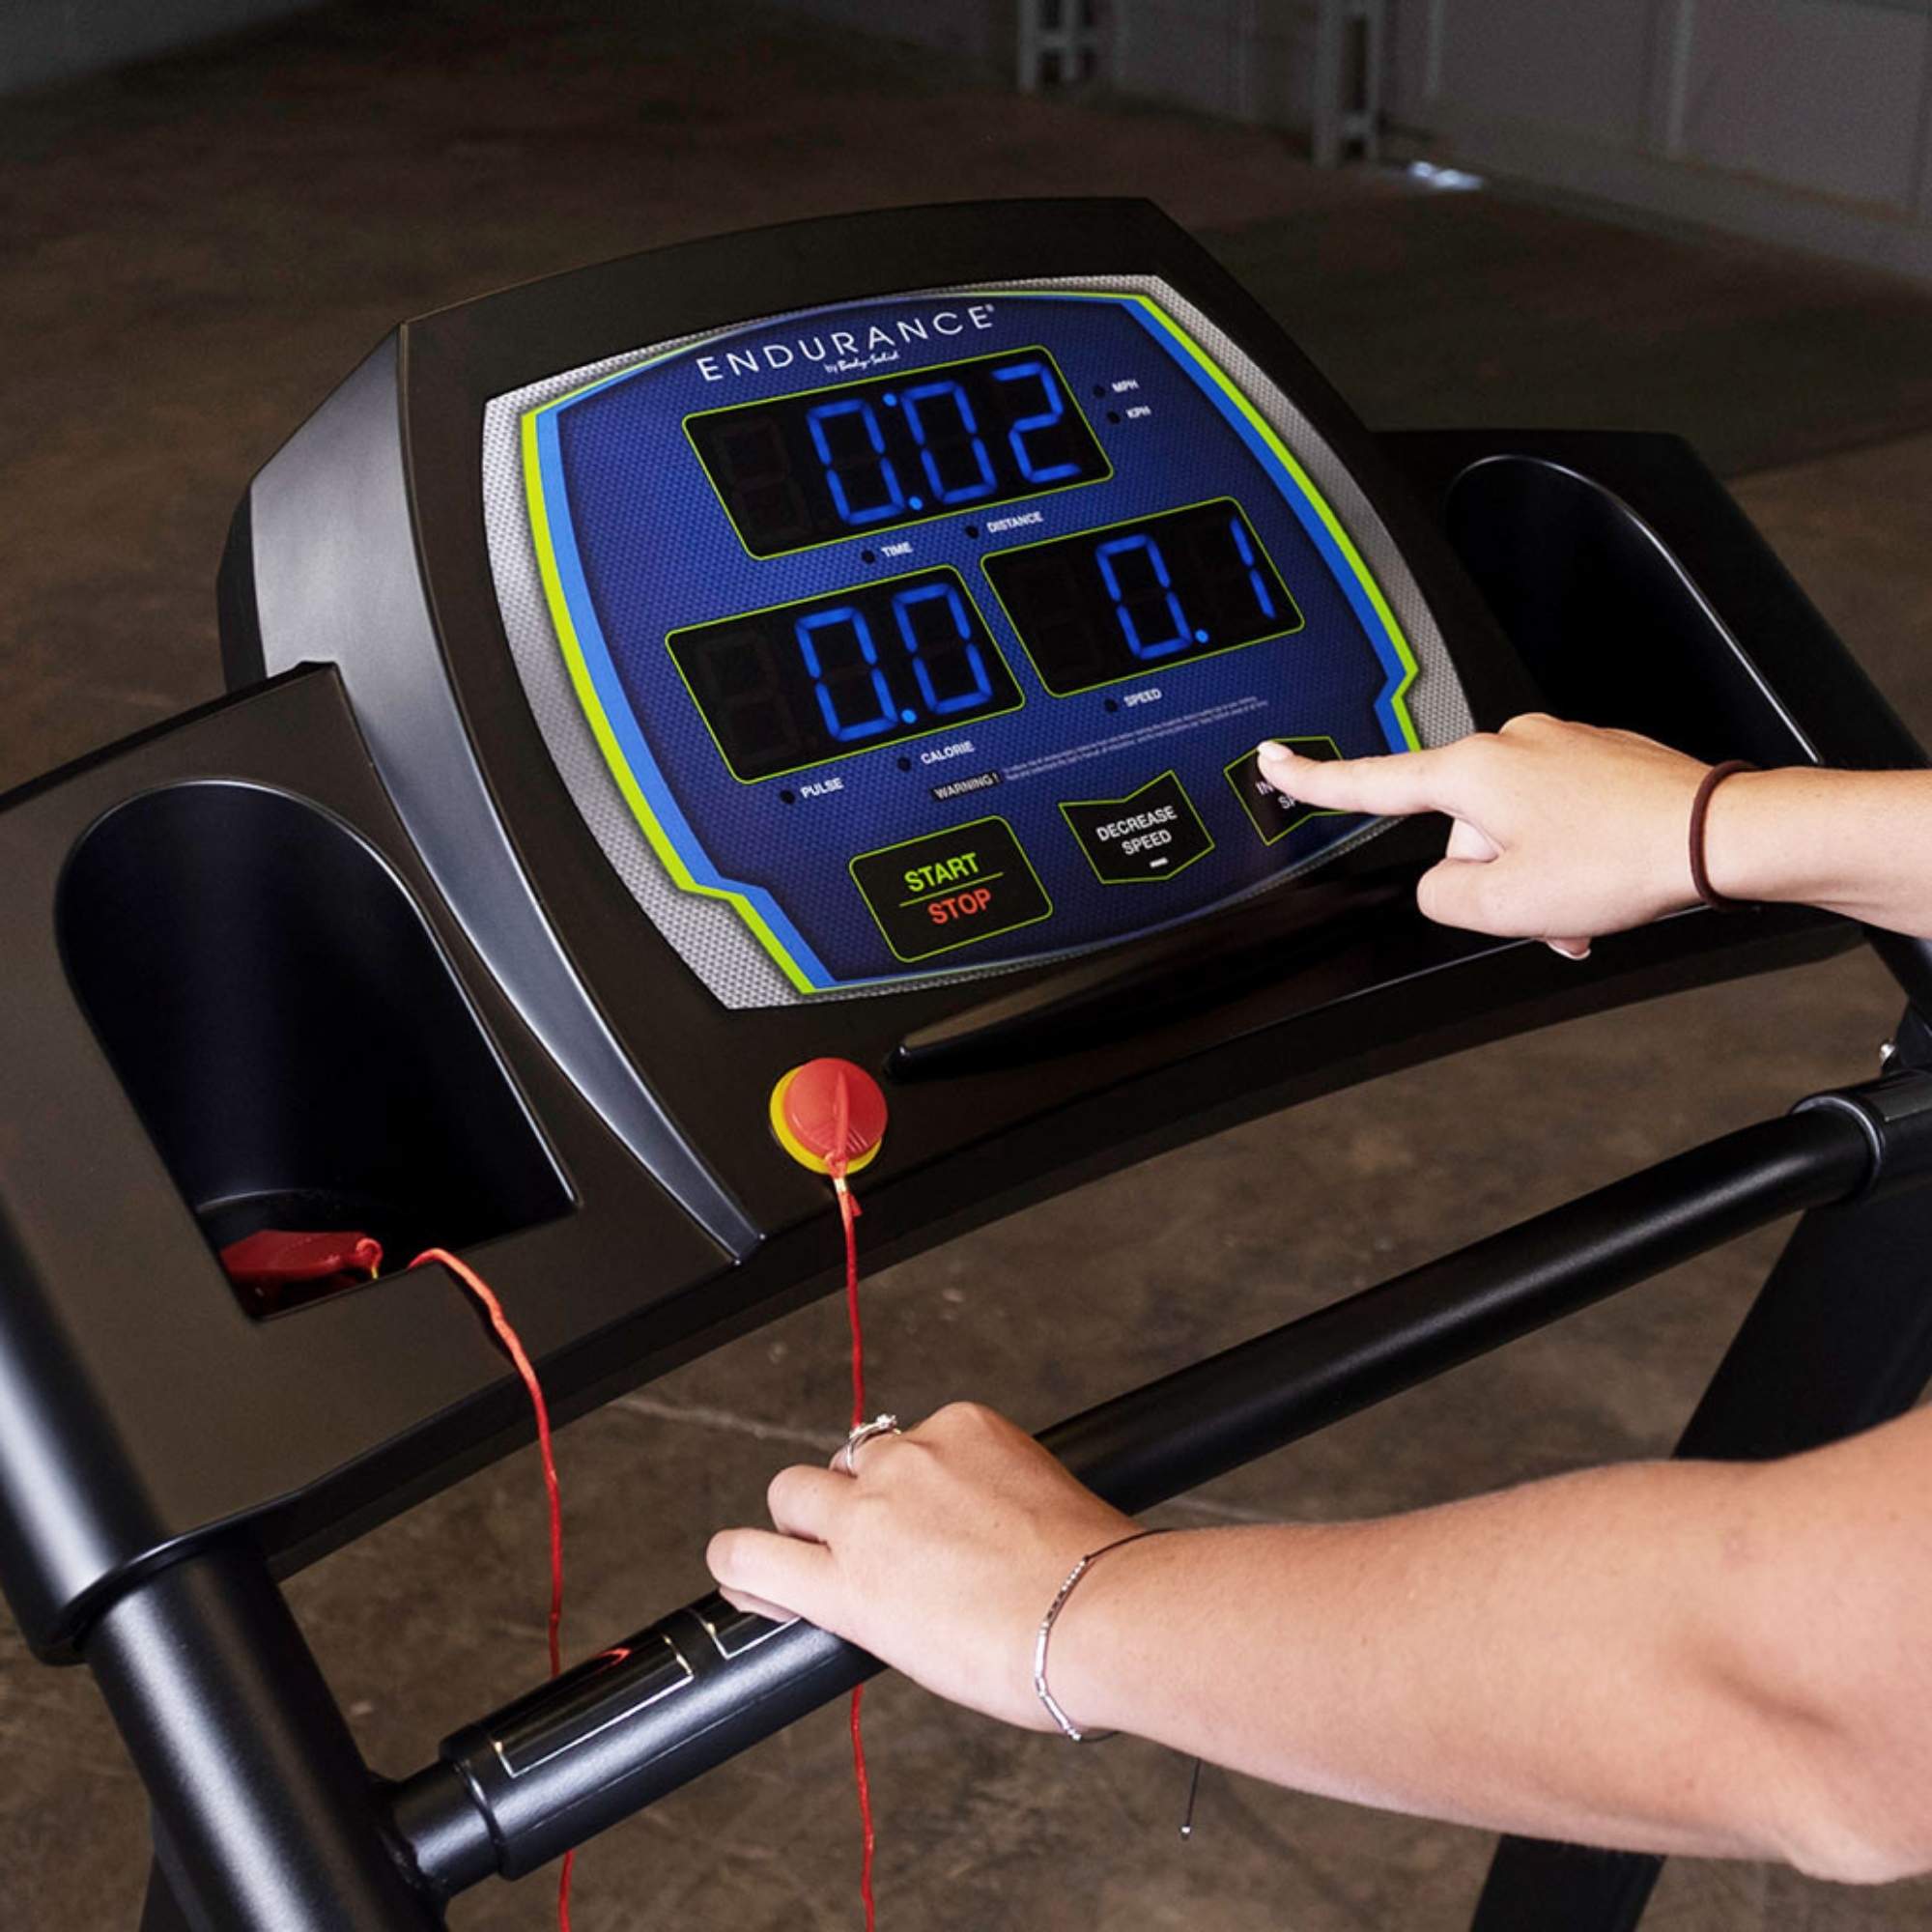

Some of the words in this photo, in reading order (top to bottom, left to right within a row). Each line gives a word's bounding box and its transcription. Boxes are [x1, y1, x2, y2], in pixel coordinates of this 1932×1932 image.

[696, 305, 993, 382] ENDURANCE
[1112, 380, 1140, 393] MPH
[1125, 406, 1152, 418] KPH
[986, 510, 1044, 534] DISTANCE
[881, 542, 914, 557] TIME
[796, 584, 990, 741] 0.0
[1123, 689, 1162, 708] SPEED
[920, 741, 975, 766] CALORIE
[800, 777, 844, 799] PULSE
[1096, 806, 1178, 841] DECREASE
[1122, 830, 1172, 856] SPEED
[904, 853, 980, 894] START
[927, 888, 993, 924] STOP
